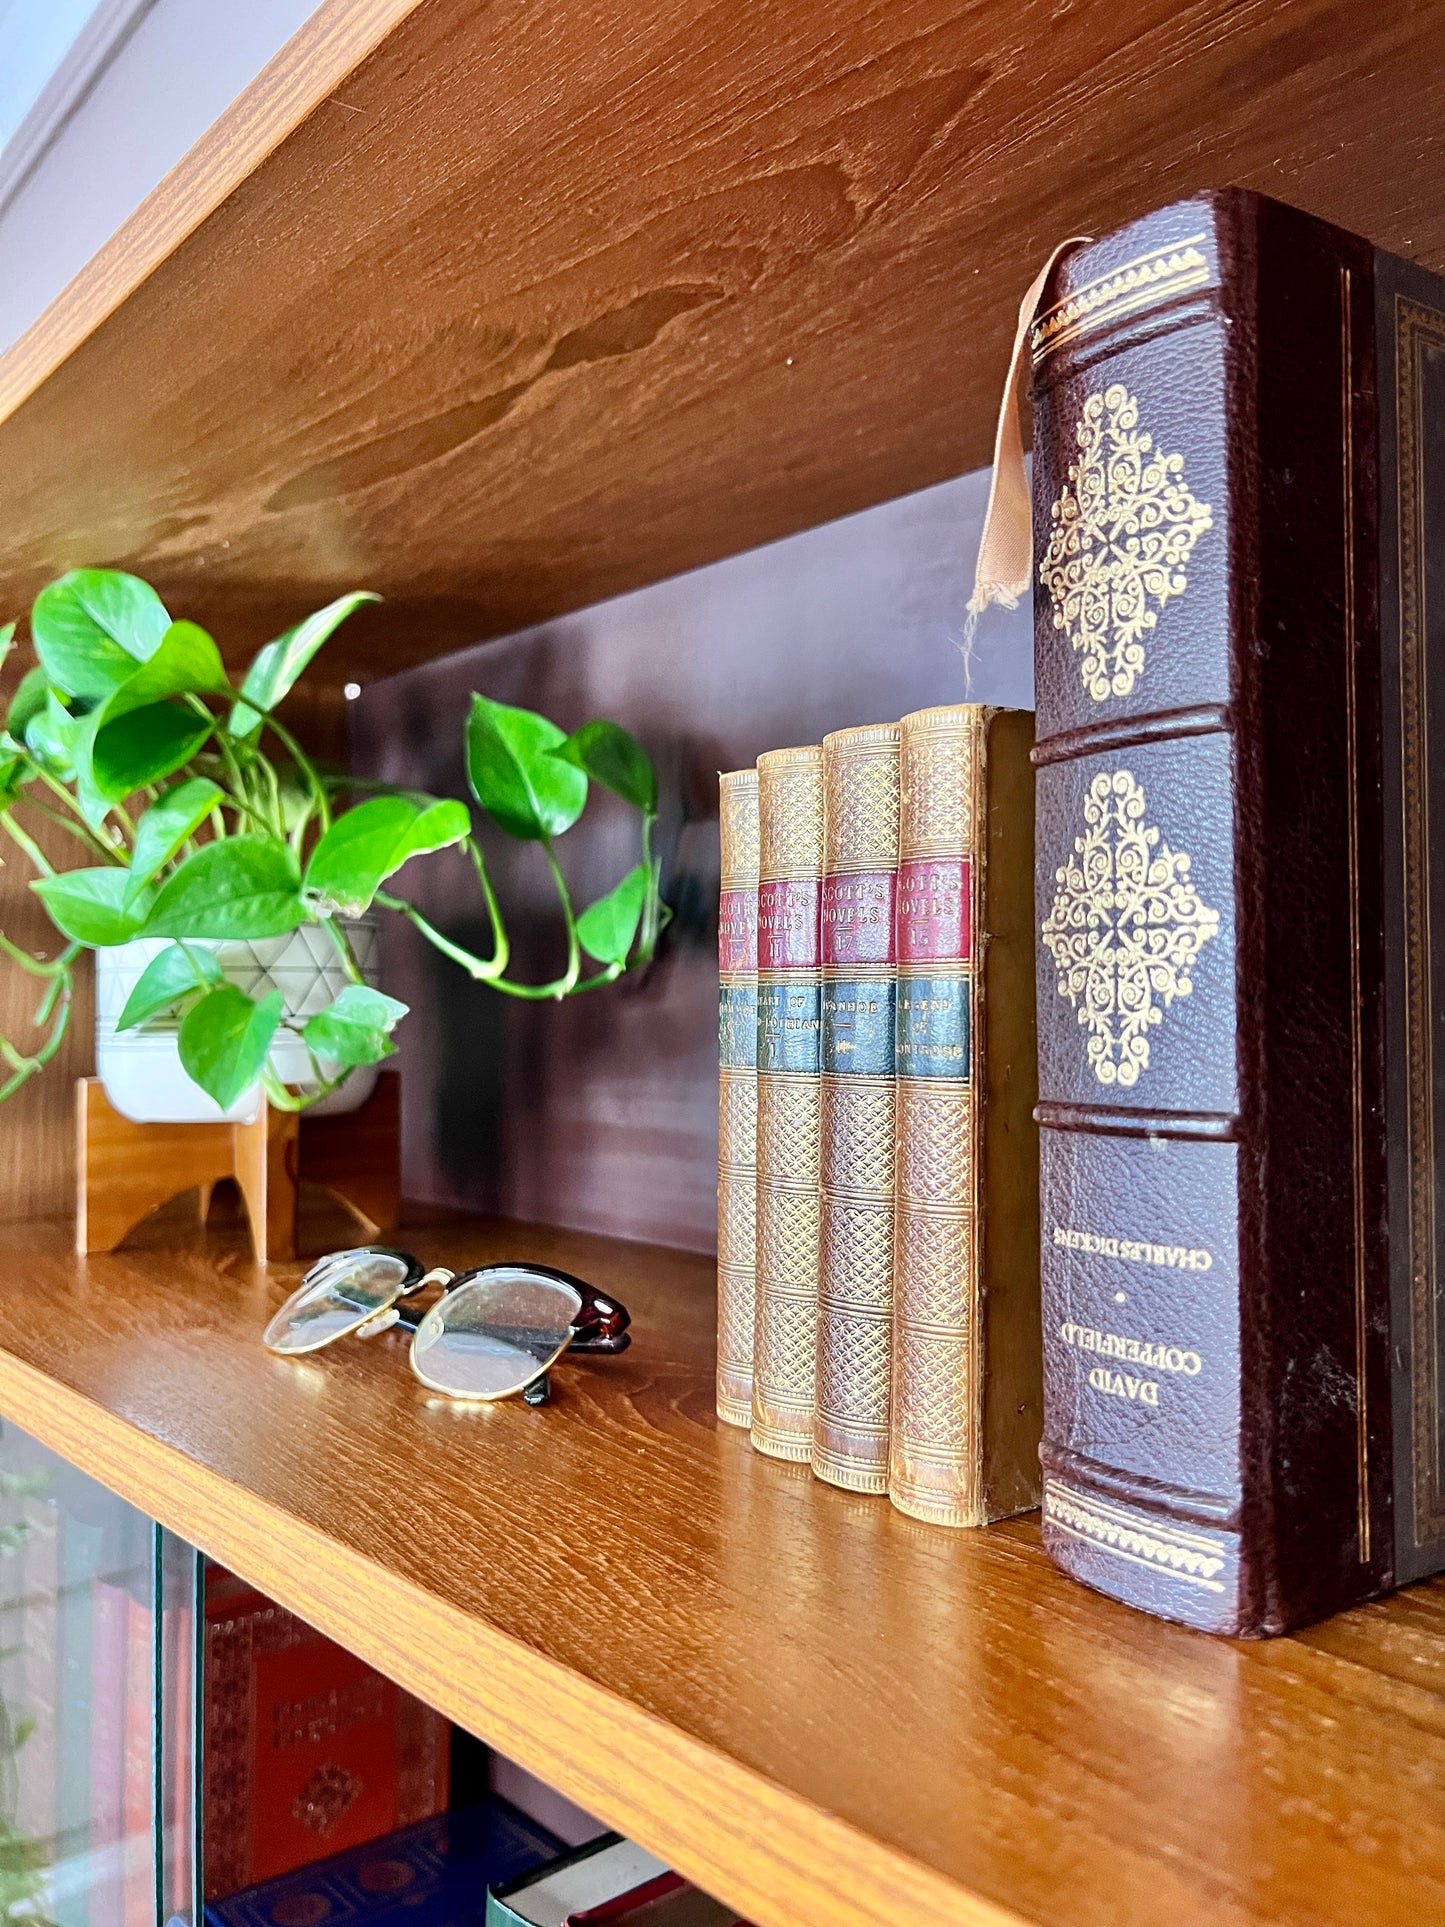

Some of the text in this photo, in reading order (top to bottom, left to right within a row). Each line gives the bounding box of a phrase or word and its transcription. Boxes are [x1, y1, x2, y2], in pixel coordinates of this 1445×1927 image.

[898, 873, 963, 892] OTT'S
[823, 883, 886, 901] SCOTT'S
[898, 897, 955, 915] OVELS
[837, 934, 854, 951] 17
[757, 995, 806, 1008] EART OF
[895, 1041, 963, 1058] ONTROSE
[1053, 1226, 1214, 1272] CHARLES DICKENS
[1061, 1322, 1203, 1376] COPPERFIELD
[1088, 1367, 1160, 1406] DAVID
